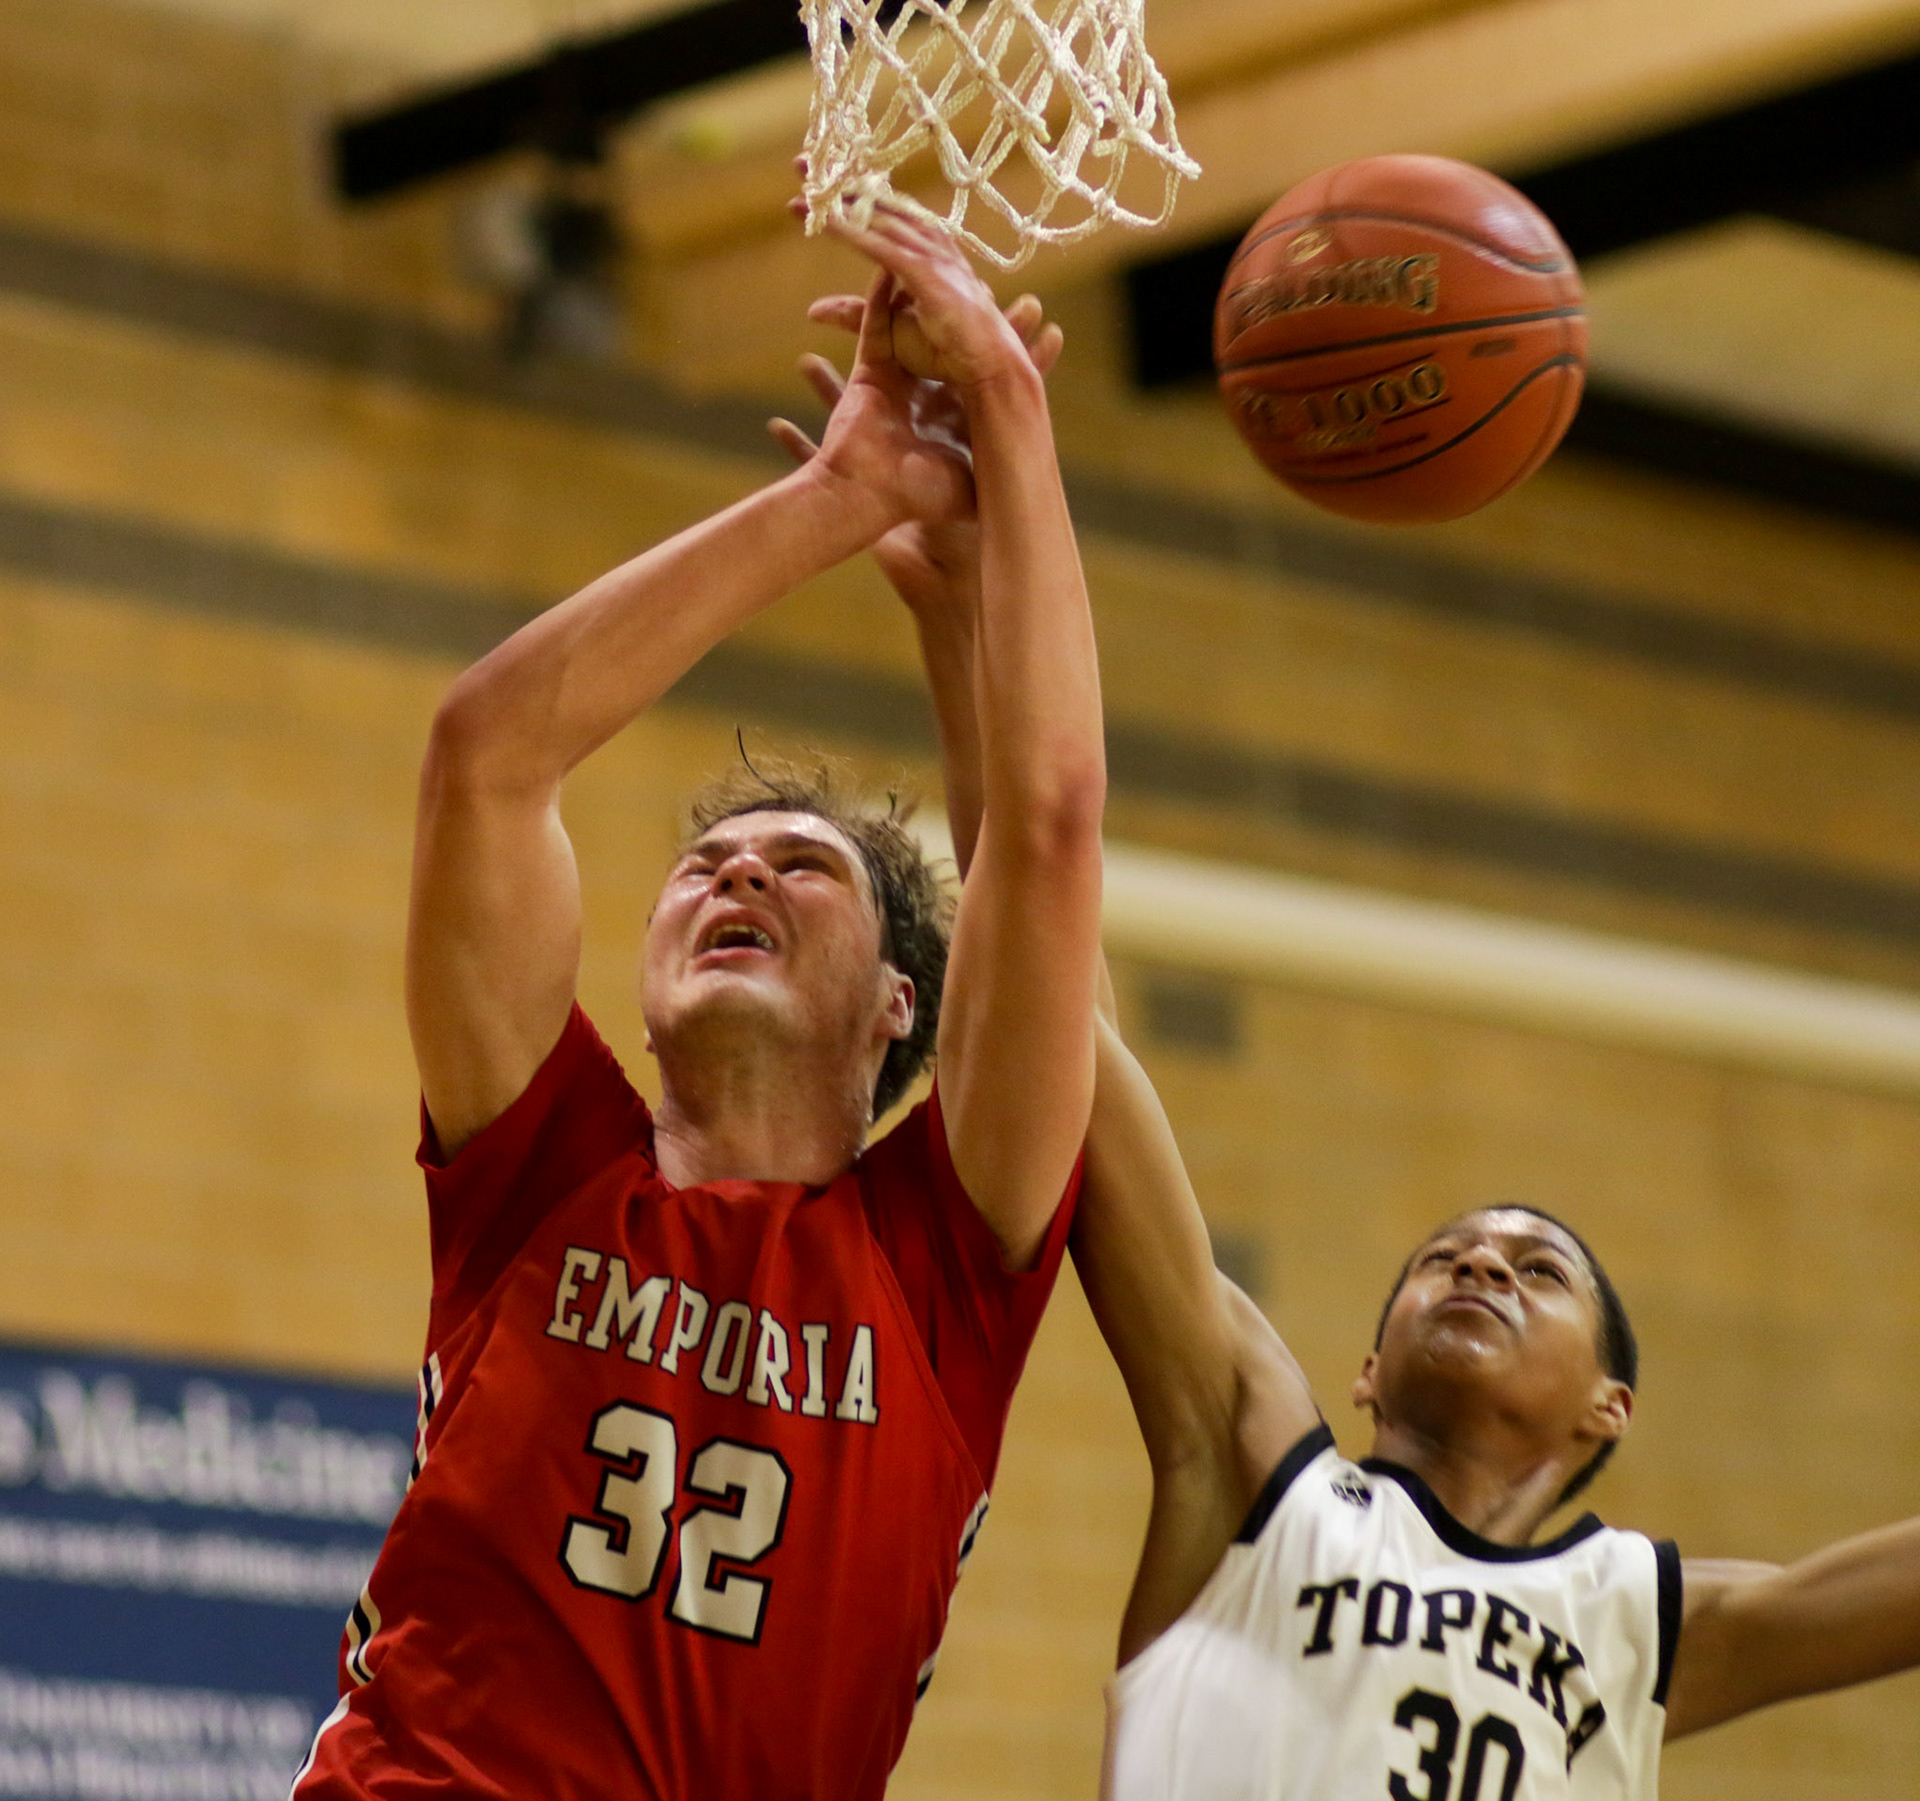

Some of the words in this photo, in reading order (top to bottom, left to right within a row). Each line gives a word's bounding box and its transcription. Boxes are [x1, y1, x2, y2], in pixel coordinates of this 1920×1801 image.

[546, 1246, 879, 1425] EMPORIA
[557, 1398, 794, 1648] 32
[1387, 1687, 1525, 1801] 30
